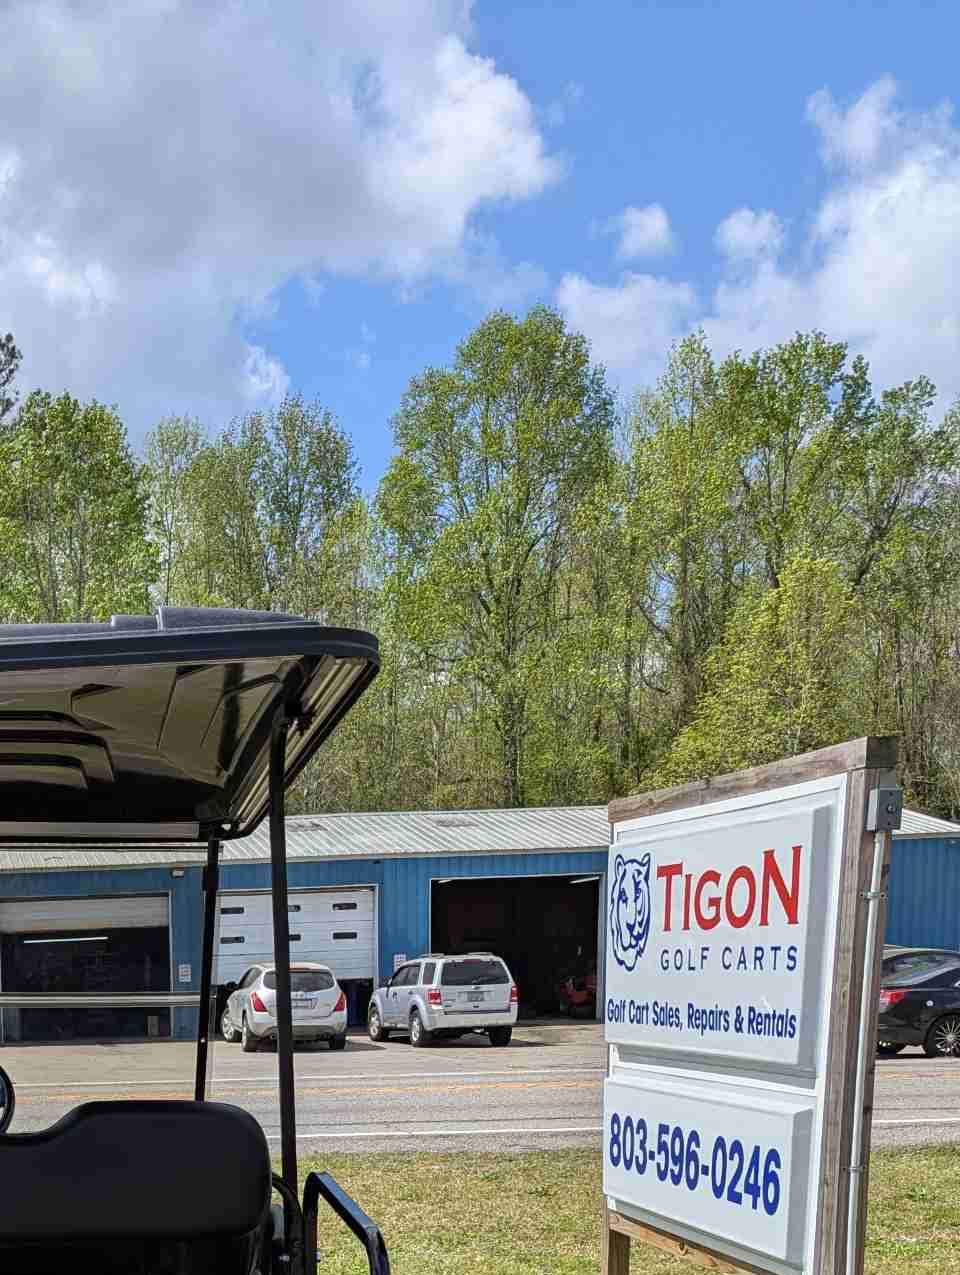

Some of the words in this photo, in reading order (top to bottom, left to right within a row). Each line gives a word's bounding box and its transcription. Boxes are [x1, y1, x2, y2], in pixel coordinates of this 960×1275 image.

[660, 946, 710, 971] GOLF
[721, 945, 798, 971] CARTS
[607, 998, 626, 1022] Golf
[629, 1000, 649, 1023] Cart
[652, 1001, 683, 1030] Sales,
[688, 1002, 730, 1036] Repairs
[734, 1005, 744, 1034] &
[748, 1006, 797, 1039] Rentals
[609, 1112, 782, 1216] 803-596-0246
